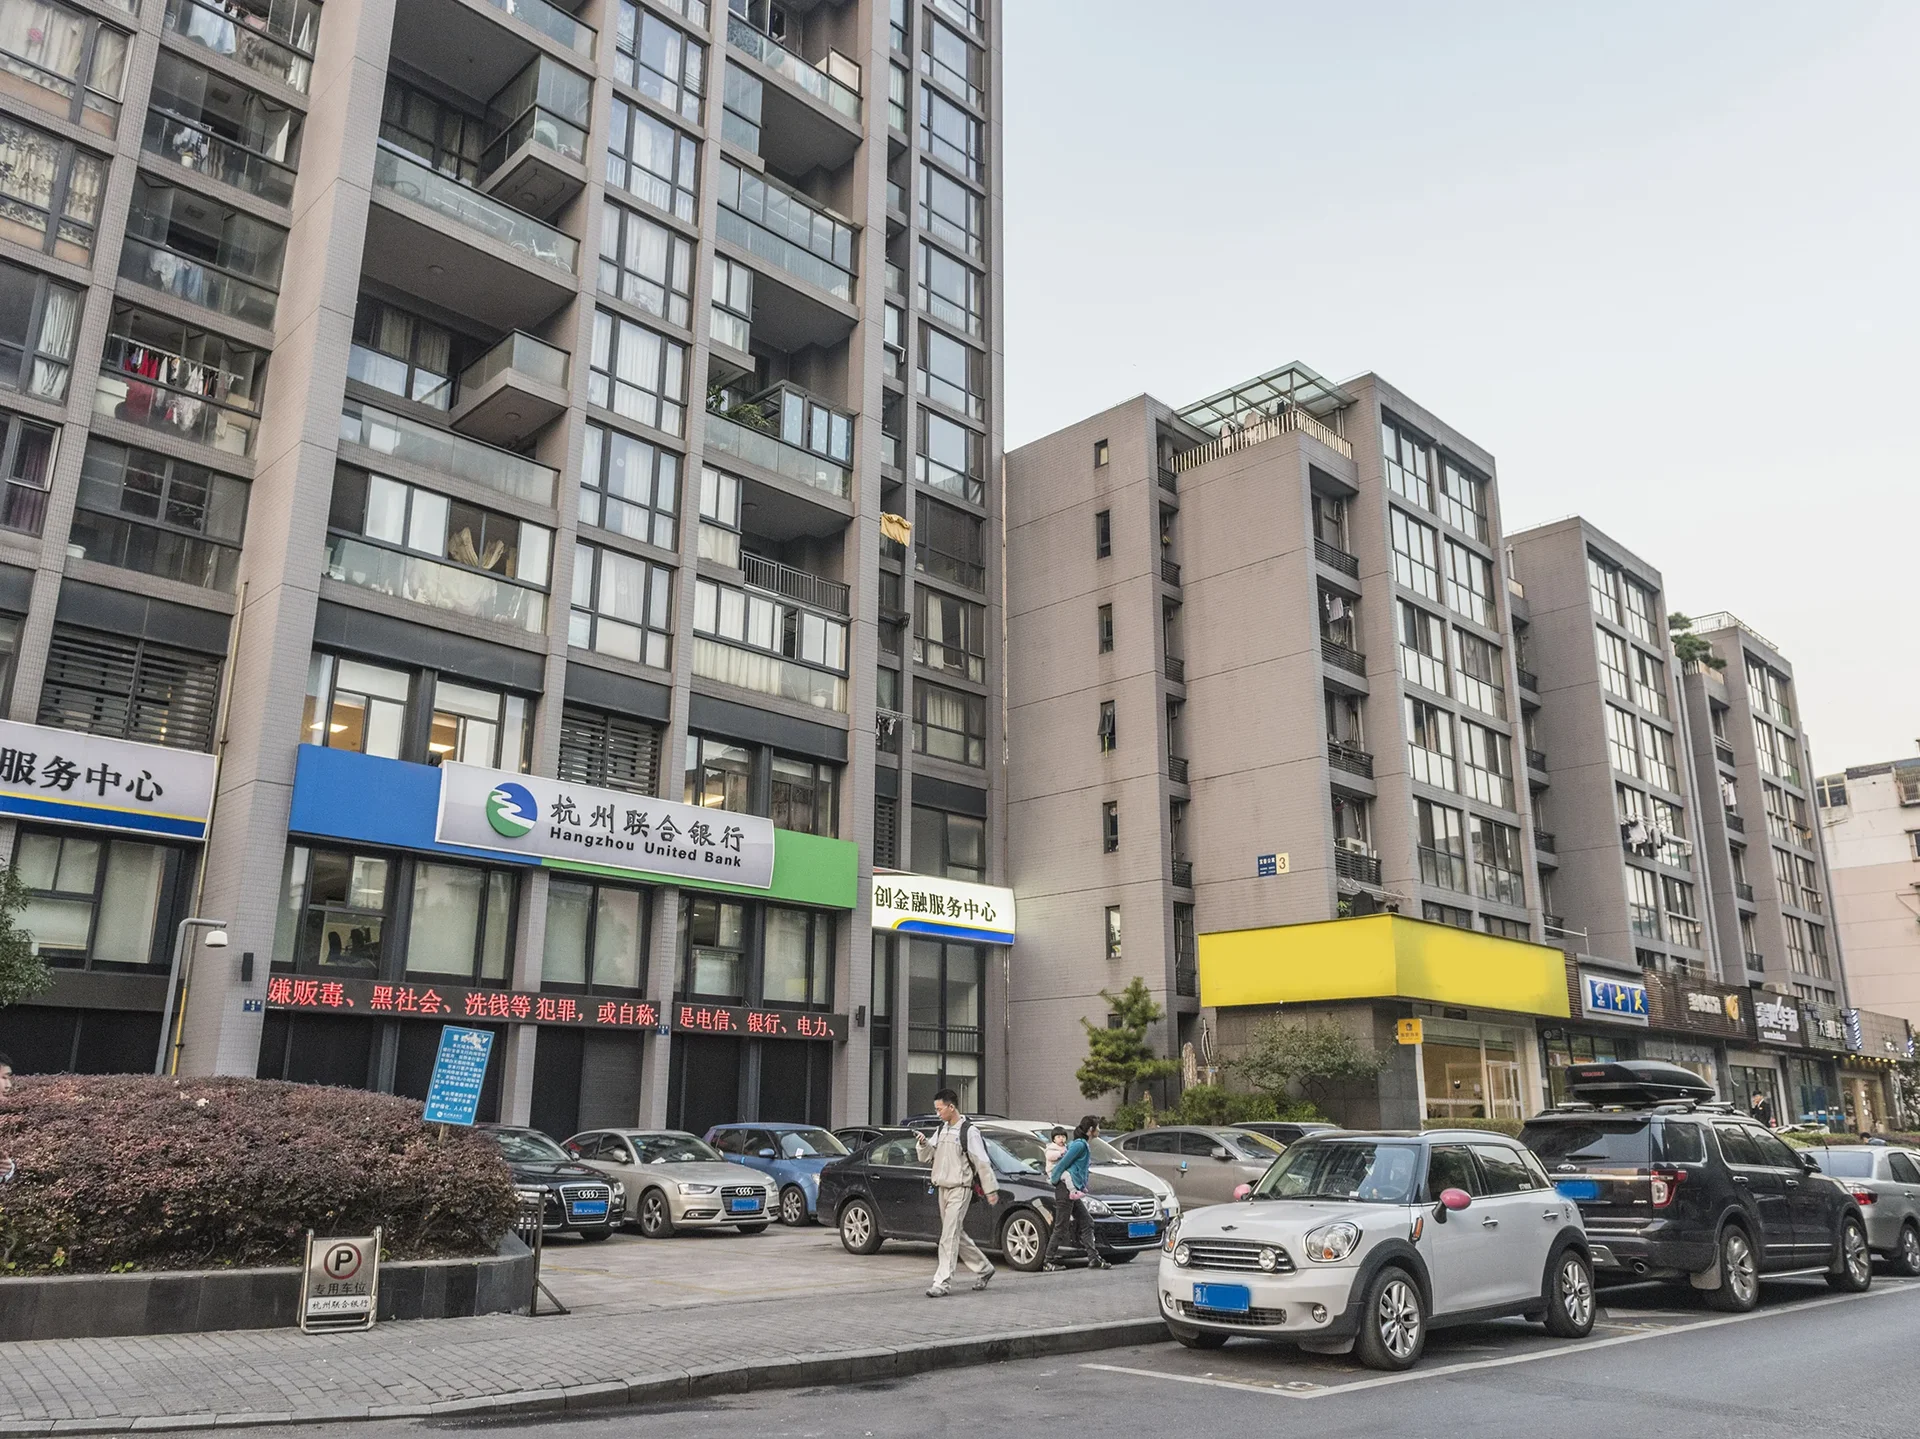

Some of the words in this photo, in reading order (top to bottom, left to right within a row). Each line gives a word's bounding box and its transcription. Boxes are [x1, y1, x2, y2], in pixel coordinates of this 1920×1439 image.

[0, 747, 163, 801] 服务中心
[551, 794, 744, 852] 杭州联合银行
[550, 826, 634, 851] Hangzhou
[644, 844, 697, 861] United
[704, 851, 742, 867] Bank
[1279, 857, 1286, 870] 3
[874, 885, 996, 922] 创金融服务中心
[267, 977, 659, 1026] 嫌贩毒、黑社会、洗钱等犯罪，或自称
[335, 1250, 353, 1271] P
[312, 1300, 368, 1310] 杭州联合银行
[315, 1282, 367, 1295] 专用车位
